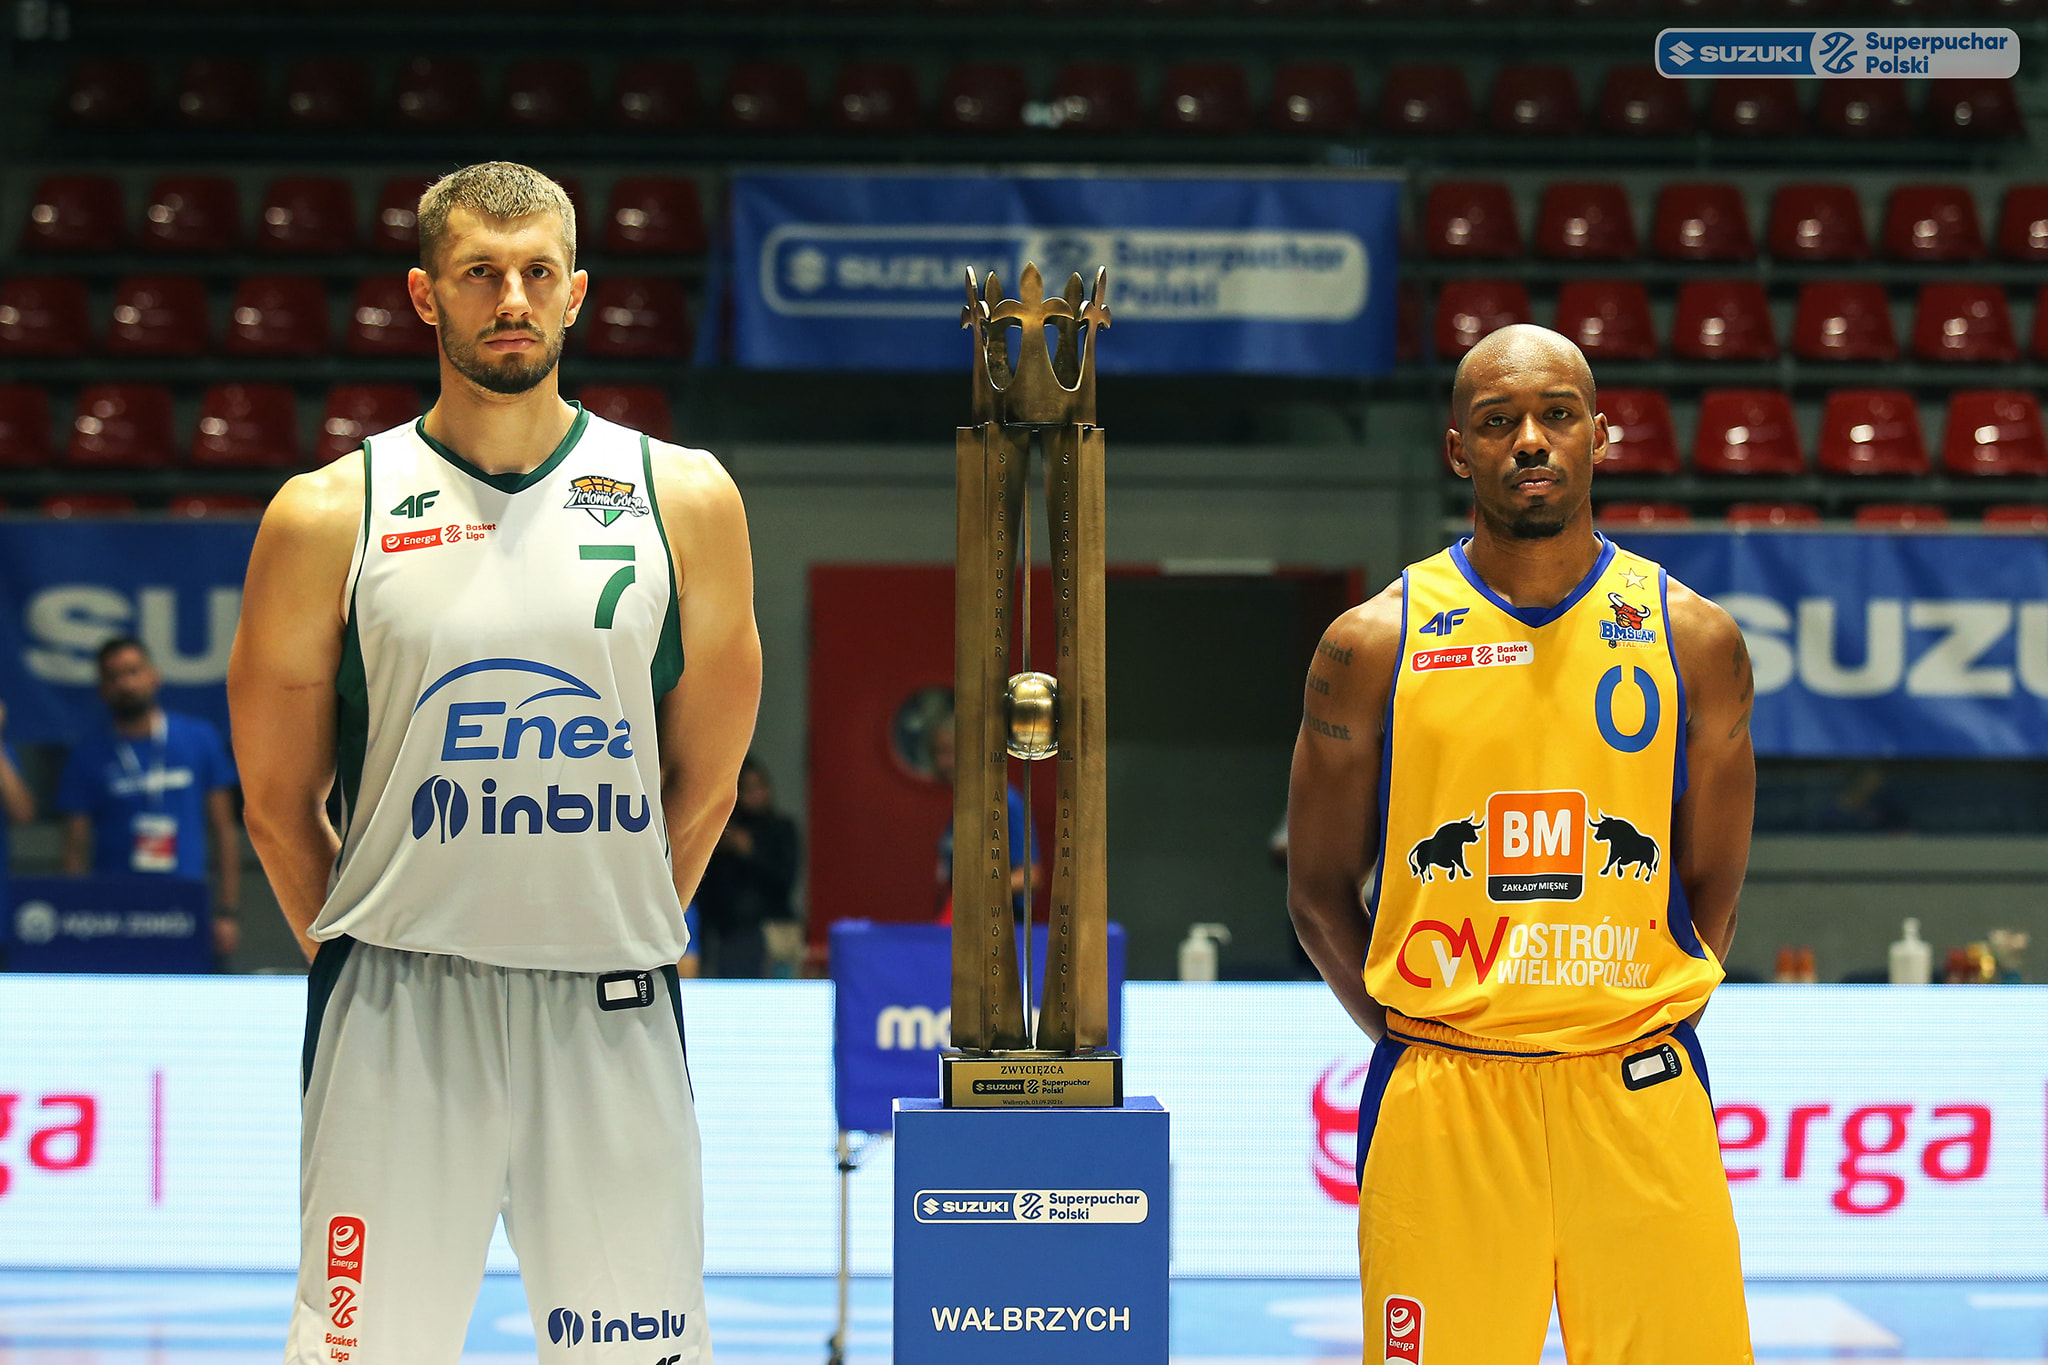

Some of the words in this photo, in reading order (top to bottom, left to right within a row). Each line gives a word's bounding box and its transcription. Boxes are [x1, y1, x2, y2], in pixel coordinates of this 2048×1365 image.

[390, 490, 440, 519] 4F
[465, 523, 497, 531] Basket
[403, 534, 437, 545] Energa
[465, 532, 485, 541] Liga
[579, 544, 636, 630] 7
[1418, 607, 1470, 636] 4F
[1497, 645, 1528, 653] Basket
[1710, 594, 2048, 698] SUZ
[1434, 654, 1467, 664] Energa
[1497, 654, 1517, 663] Liga
[1594, 665, 1661, 753] 0
[440, 701, 634, 761] Enea
[481, 778, 651, 834] inblu
[1503, 809, 1571, 857] BM
[1502, 882, 1538, 892] ZAKŁADY
[1538, 882, 1569, 892] MIĘSNE
[1509, 916, 1640, 961] OSTRÓW
[1497, 959, 1651, 988] WIELKOPOLSKI
[1000, 1065, 1065, 1076] ZWYCIĘZCA
[985, 1083, 1022, 1091] SUZUKI
[1042, 1079, 1091, 1087] Superpuchar
[1714, 1102, 1993, 1215] erga
[1049, 1192, 1140, 1207] Superpuchar
[942, 1201, 1009, 1213] SUZUKI
[1049, 1208, 1090, 1220] Polski
[331, 1257, 359, 1270] Energa
[931, 1306, 1131, 1332] WAŁBRZYCH
[591, 1310, 686, 1343] inblu
[325, 1333, 358, 1347] Basket
[1389, 1338, 1415, 1352] Energa
[330, 1347, 350, 1363] Liga
